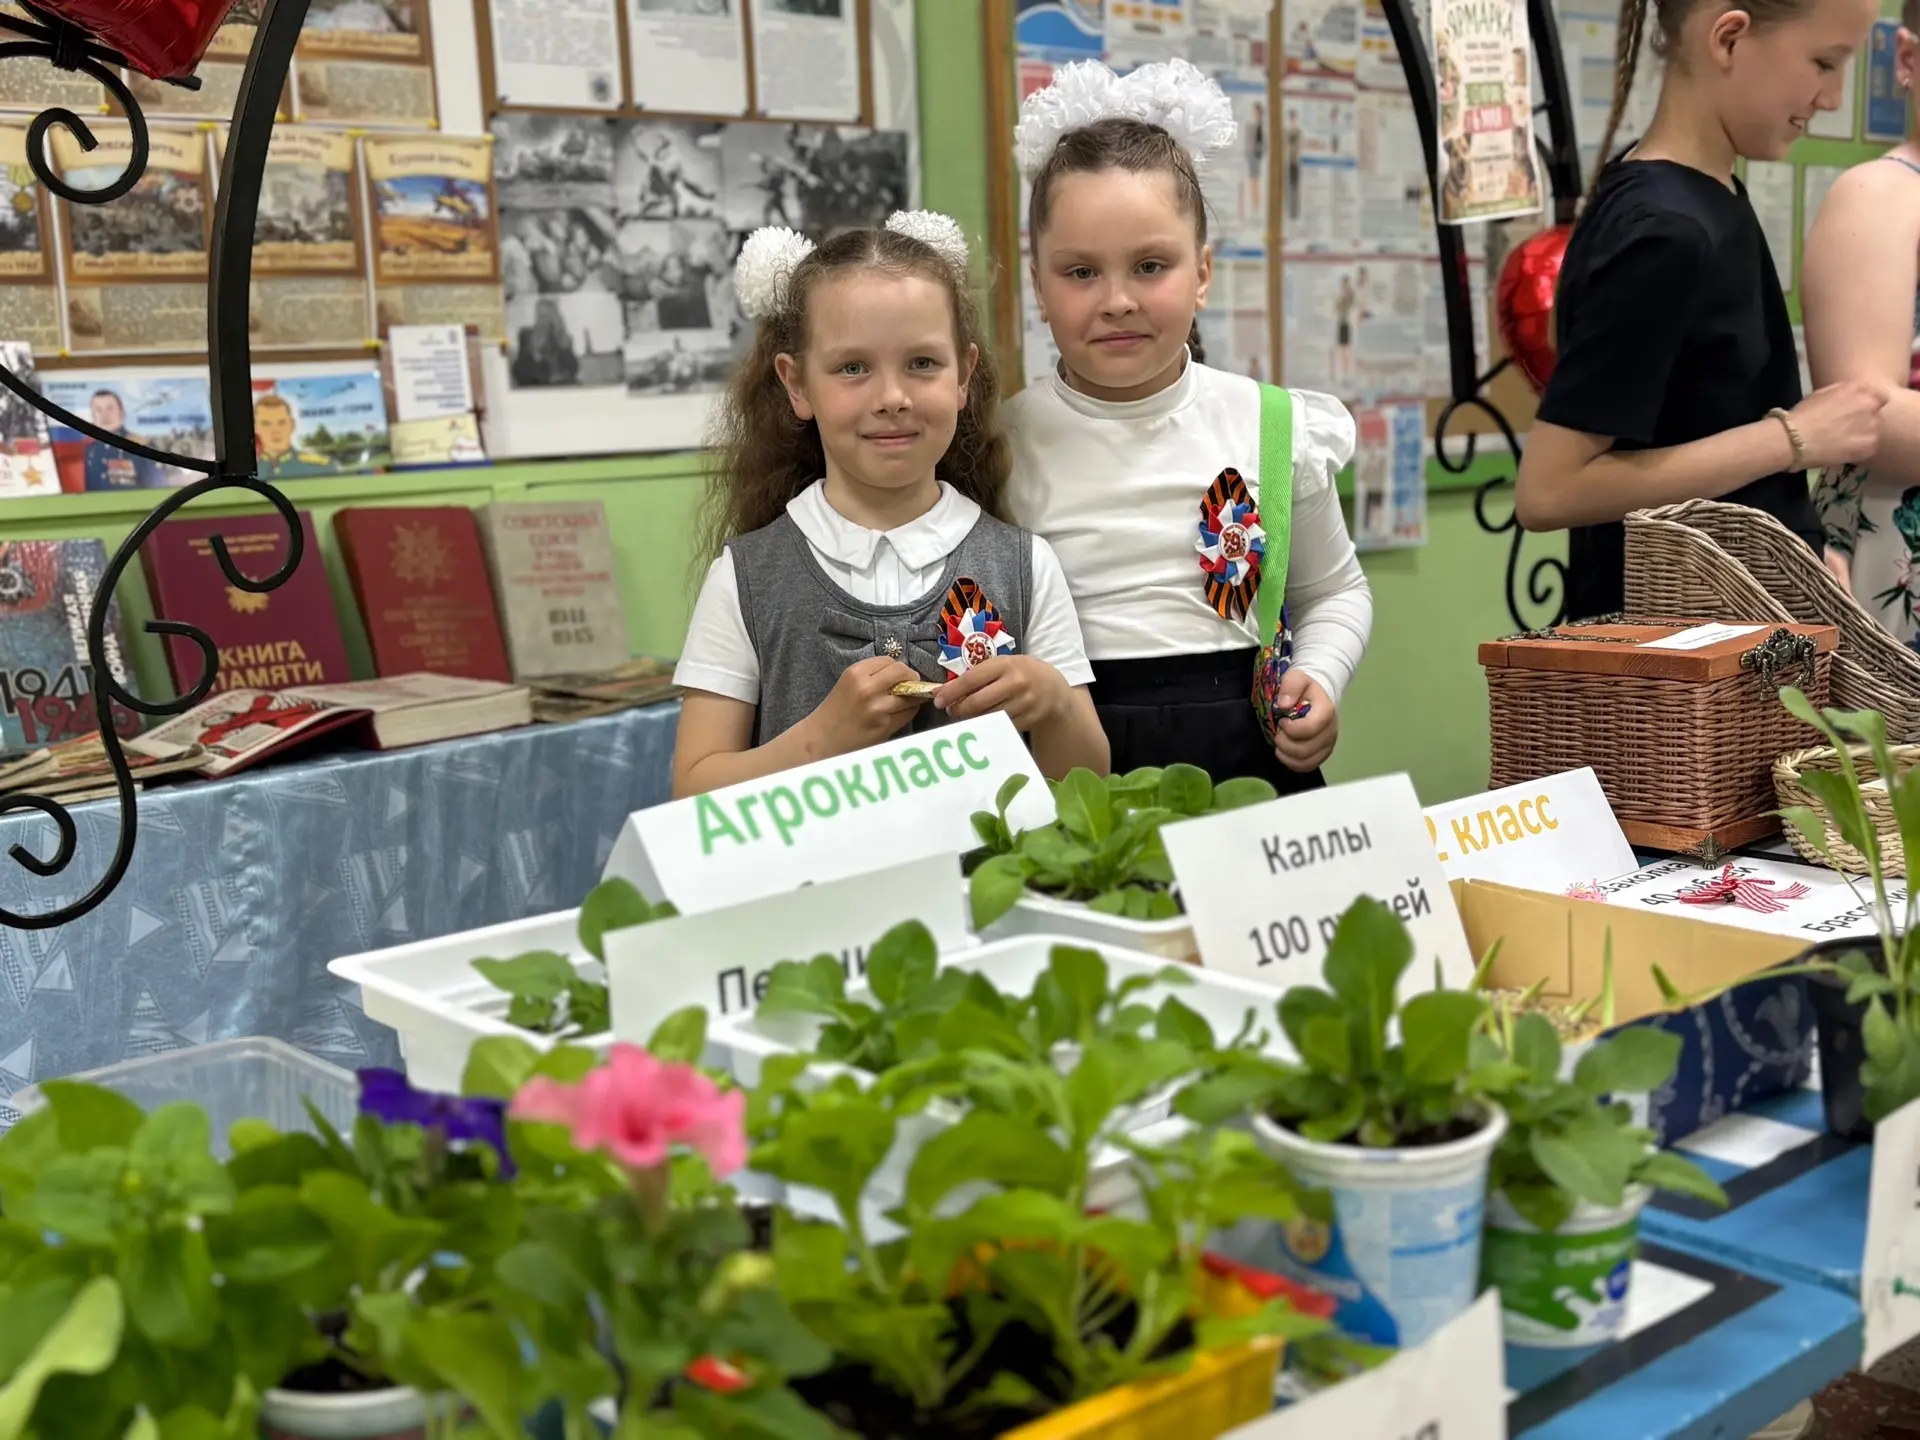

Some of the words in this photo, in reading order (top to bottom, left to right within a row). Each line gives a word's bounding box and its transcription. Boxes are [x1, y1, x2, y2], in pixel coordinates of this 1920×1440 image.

[210, 660, 324, 692] ПАМЯТИ
[217, 640, 306, 667] КНИГА
[694, 731, 990, 855] Агрокласс
[1260, 822, 1372, 875] Каллы
[1450, 794, 1559, 855] класс
[1248, 915, 1312, 968] 100
[1317, 876, 1432, 948] рей
[1640, 892, 1680, 906] 40
